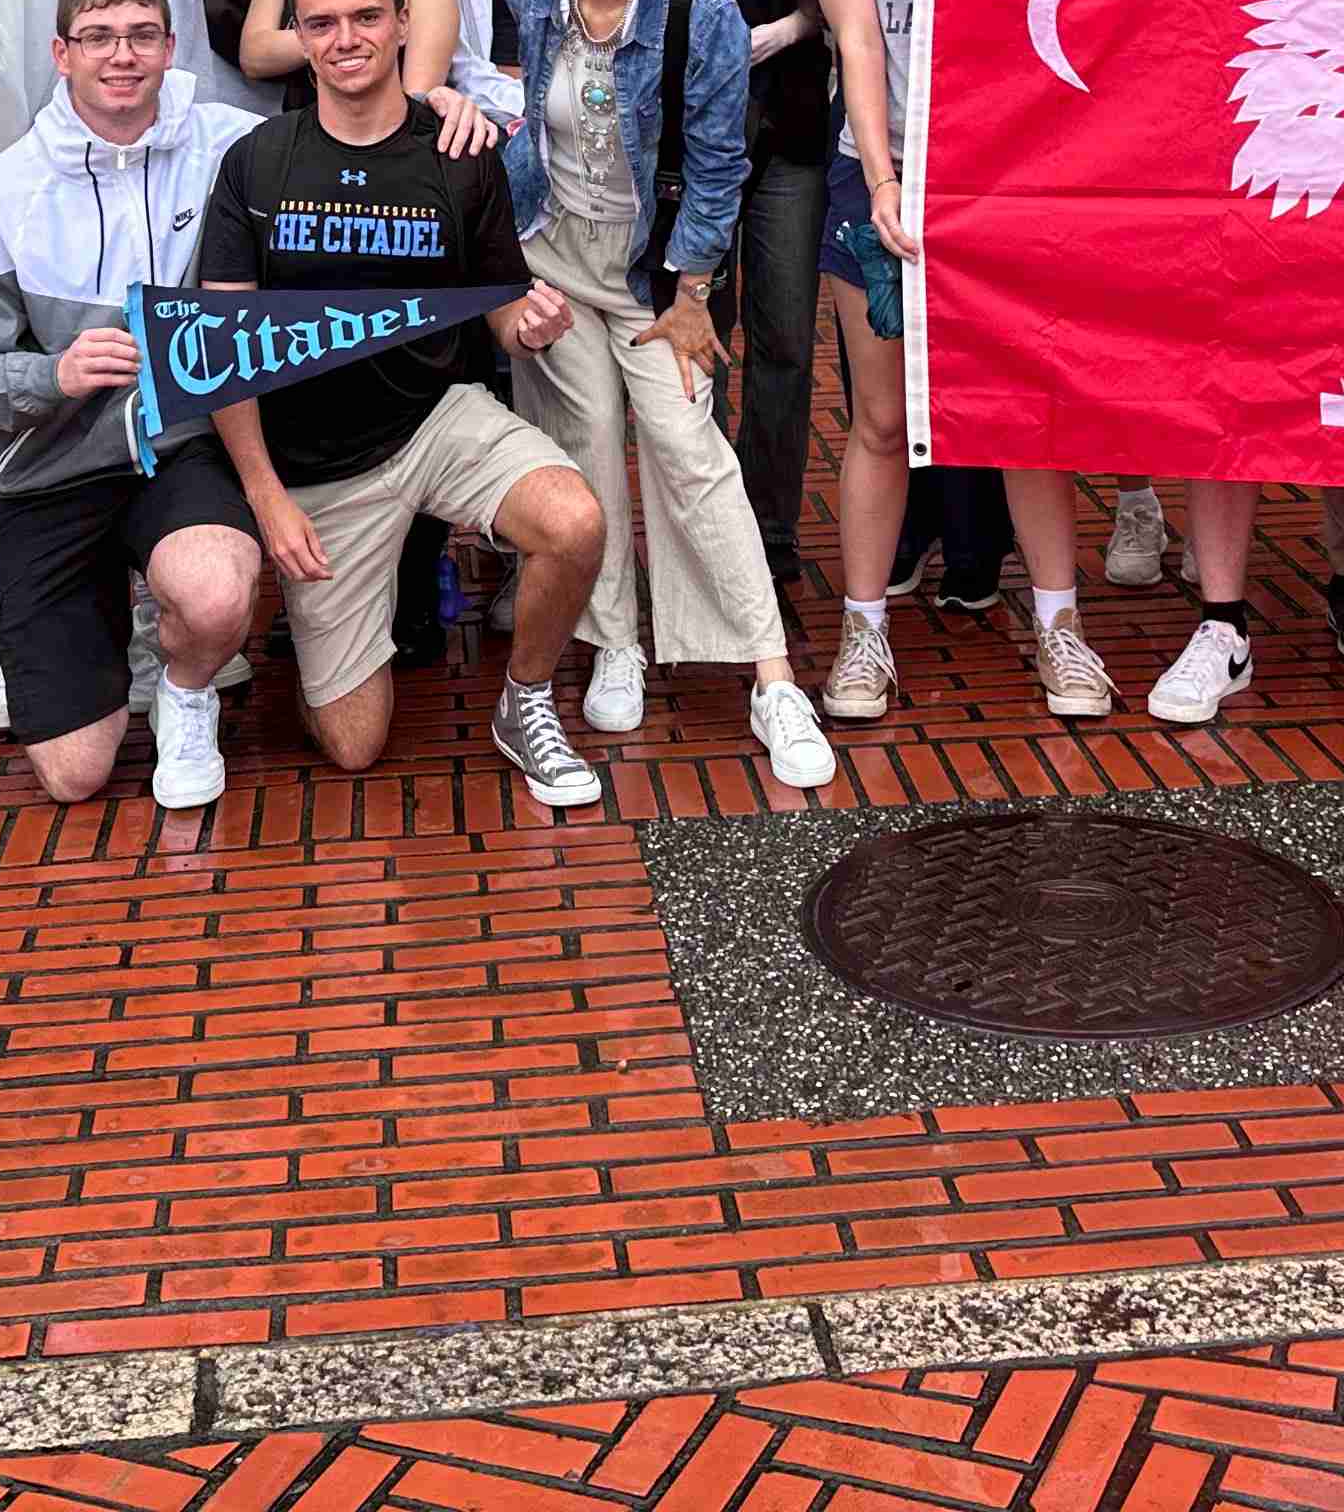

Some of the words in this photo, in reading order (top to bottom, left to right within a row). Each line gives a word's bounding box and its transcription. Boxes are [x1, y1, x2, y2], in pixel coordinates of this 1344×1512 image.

[280, 200, 314, 211] ONOR
[324, 202, 363, 214] DUTY
[373, 205, 436, 218] RESPECT
[323, 215, 446, 258] CITADEL
[153, 299, 201, 321] The
